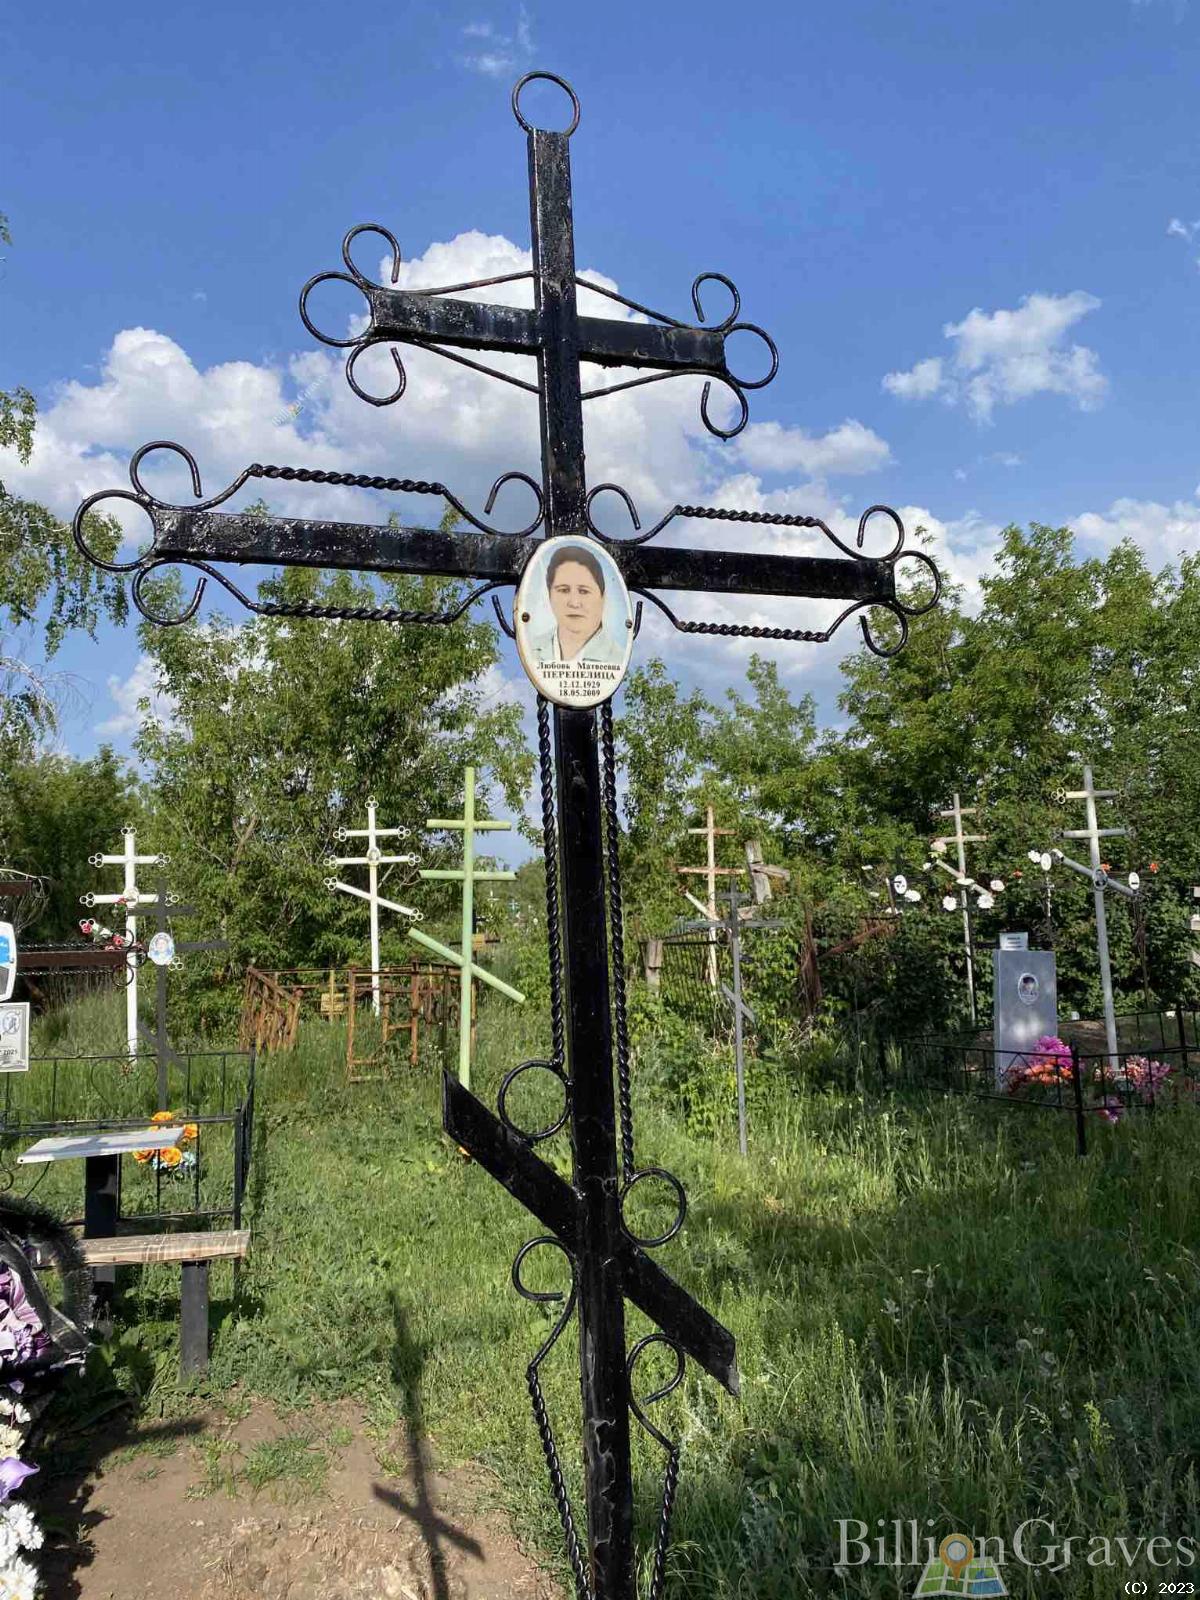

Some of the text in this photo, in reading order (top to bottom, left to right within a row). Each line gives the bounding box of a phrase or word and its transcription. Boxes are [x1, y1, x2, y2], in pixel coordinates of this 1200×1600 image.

[537, 661, 621, 671] Любовь Матвеевна
[543, 671, 616, 680] ПЕРЕПЕЛИЦА
[559, 689, 601, 697] 18.05.2009
